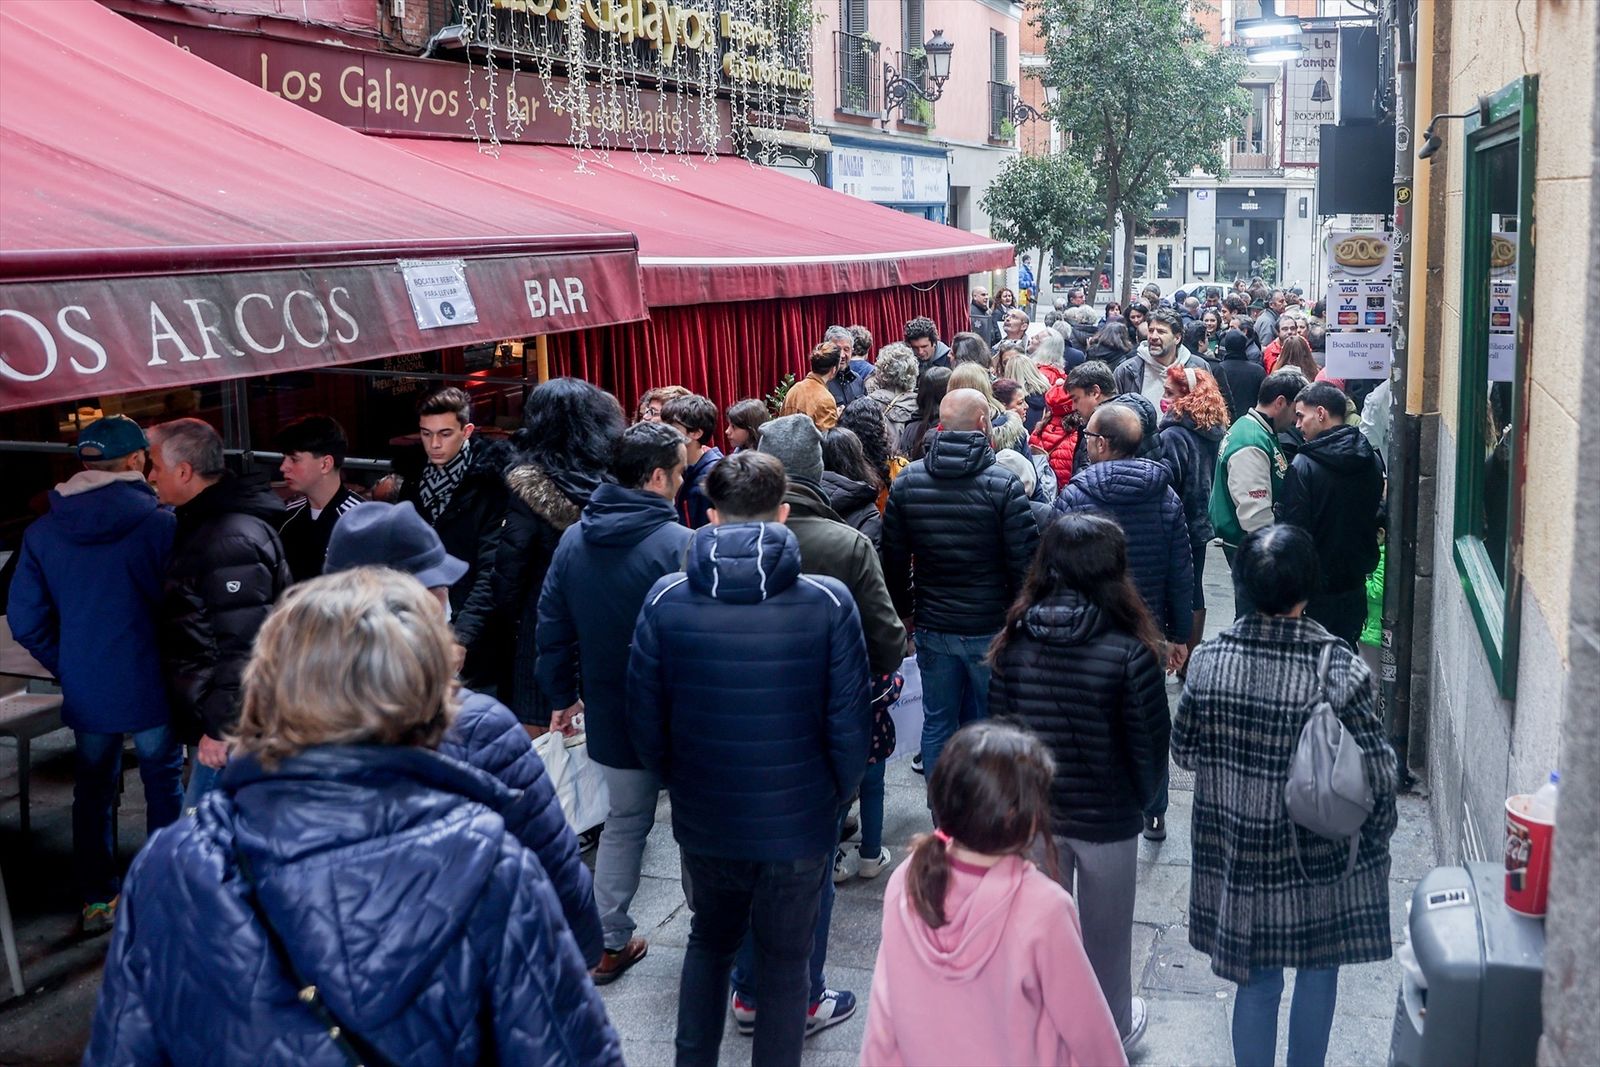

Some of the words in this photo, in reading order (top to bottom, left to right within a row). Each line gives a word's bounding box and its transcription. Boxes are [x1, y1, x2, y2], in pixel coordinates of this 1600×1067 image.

[1314, 37, 1332, 50] La
[260, 53, 322, 103] Los
[339, 65, 459, 124] Galayos
[506, 85, 540, 126] Bar
[413, 277, 435, 287] BOCATA
[524, 276, 589, 318] BAR
[147, 286, 360, 367] ARCOS
[1332, 341, 1368, 349] Bocadillos
[1369, 343, 1384, 351] para
